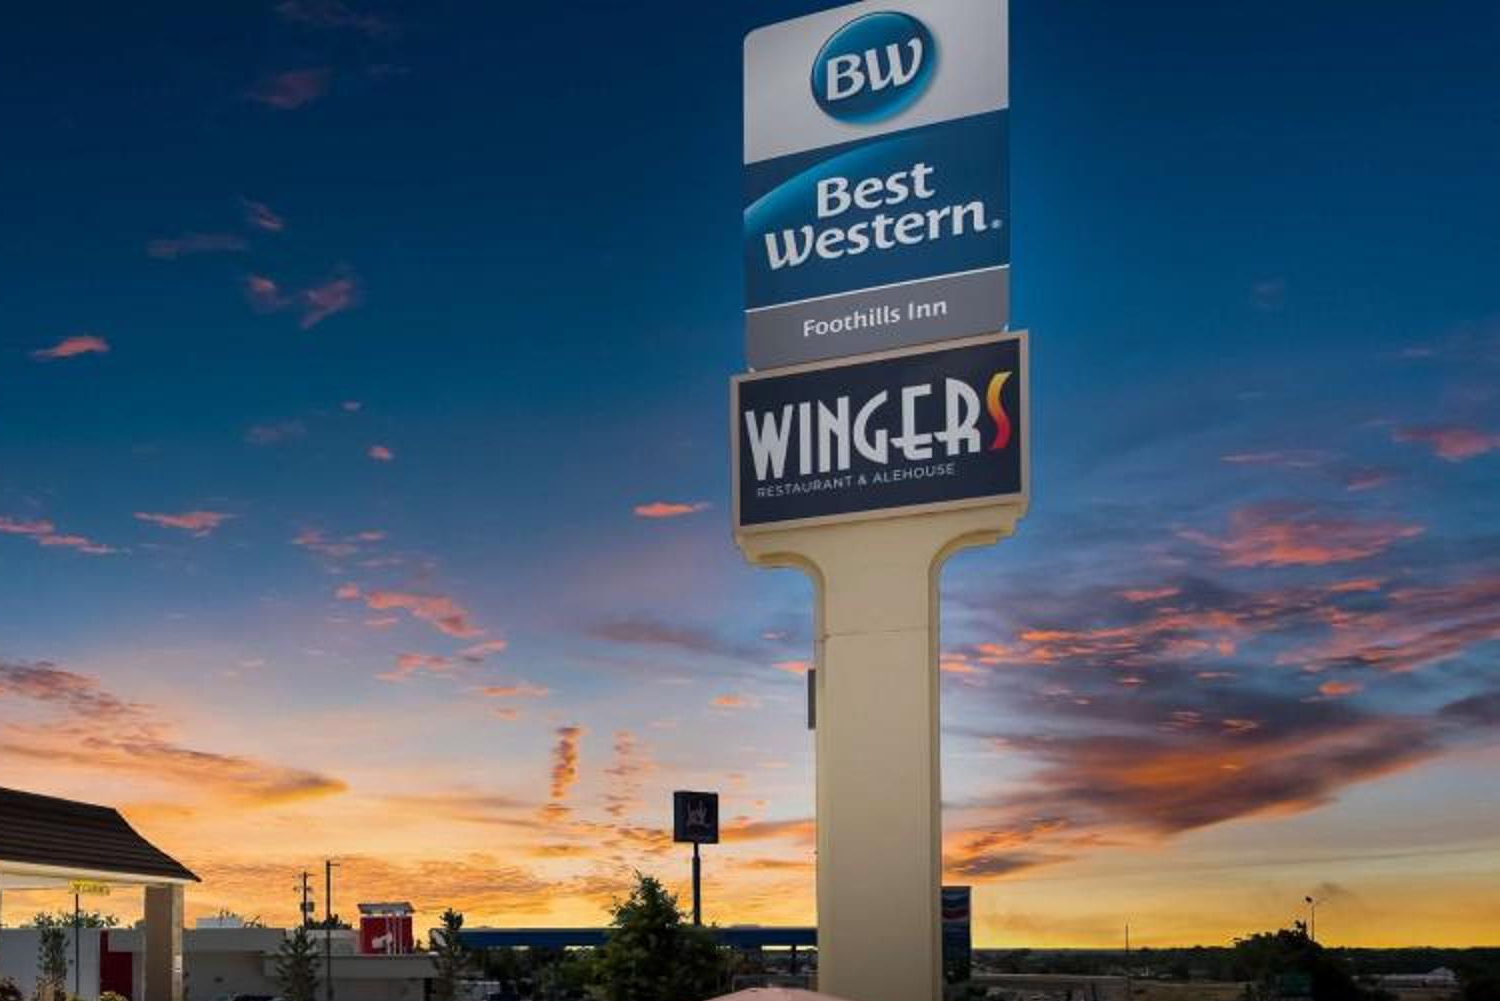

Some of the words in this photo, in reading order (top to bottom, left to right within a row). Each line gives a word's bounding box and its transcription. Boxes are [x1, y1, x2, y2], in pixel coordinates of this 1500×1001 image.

[826, 38, 924, 101] BW
[816, 162, 936, 219] Best
[803, 304, 901, 337] Foothills
[908, 300, 948, 321] Inn
[745, 371, 1012, 481] WINGERS
[756, 475, 853, 498] RESTAURANT
[857, 474, 868, 486] &
[872, 463, 956, 484] ALEHOUSE
